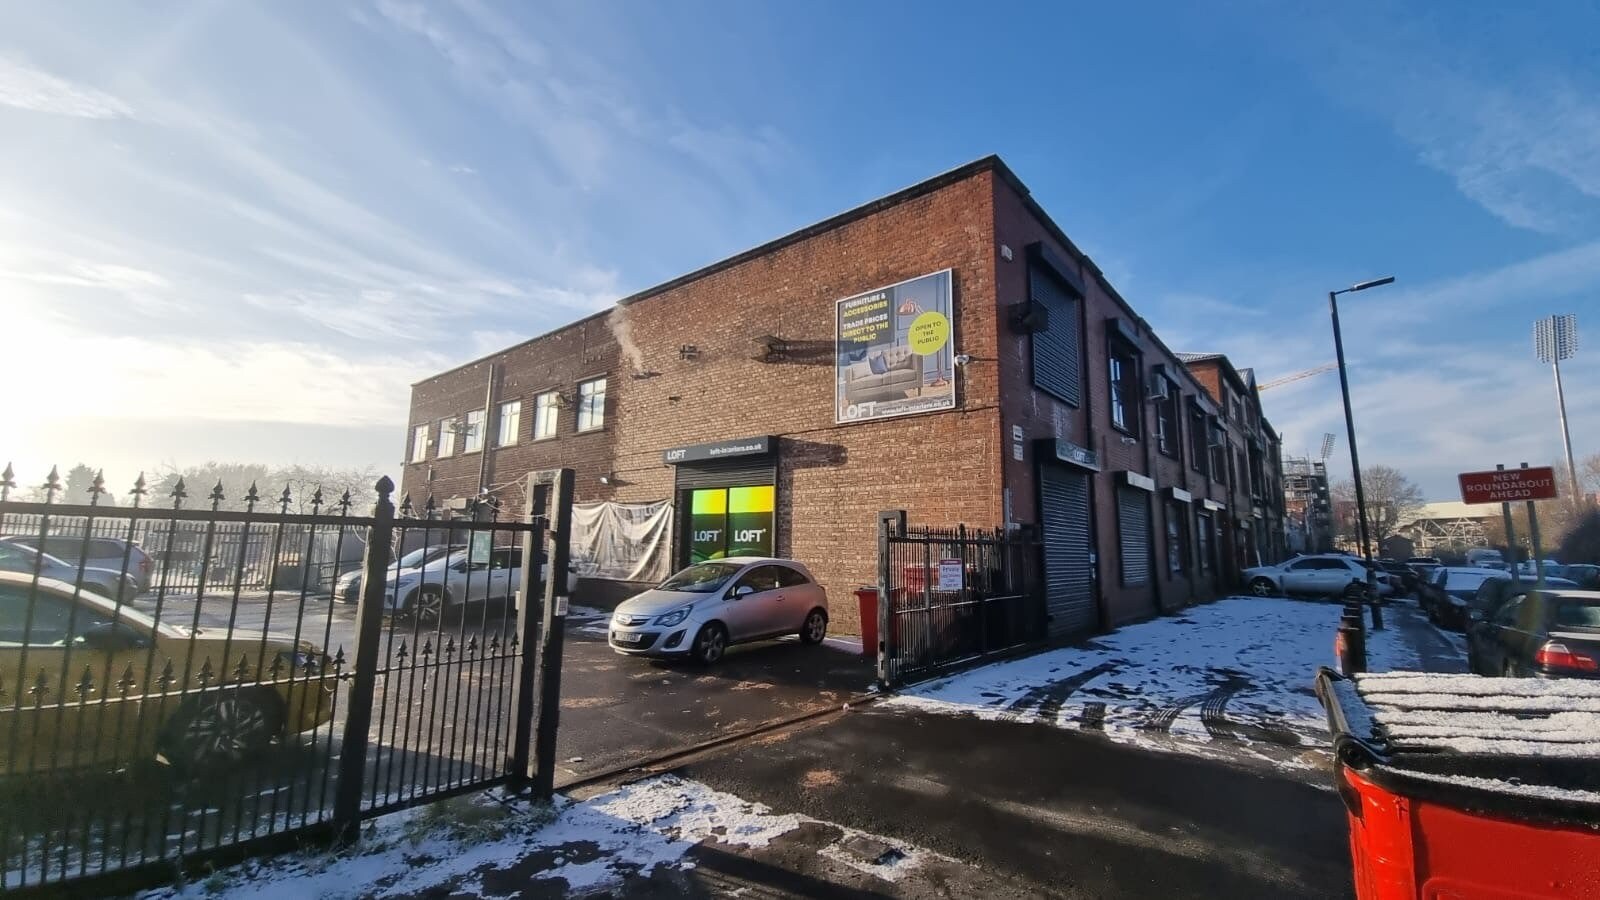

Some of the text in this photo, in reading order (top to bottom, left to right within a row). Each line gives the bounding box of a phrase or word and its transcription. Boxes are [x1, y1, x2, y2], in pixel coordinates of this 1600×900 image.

[845, 295, 880, 308] FURNITURE
[843, 301, 888, 317] ACCESSORIES
[844, 313, 888, 330] TRADE PRICES
[915, 322, 931, 331] OPEN
[843, 328, 865, 338] DIRECT
[876, 321, 889, 330] THE
[854, 333, 877, 344] PUBLIC
[918, 336, 939, 344] PUBLIC
[839, 401, 877, 420] LOFT
[667, 449, 686, 460] LOFT
[1493, 472, 1520, 482] NEW
[1466, 479, 1551, 492] ROUNDABOUT
[1490, 489, 1531, 500] AHEAD
[694, 530, 719, 542] LOFT
[734, 529, 763, 542] LOFT
